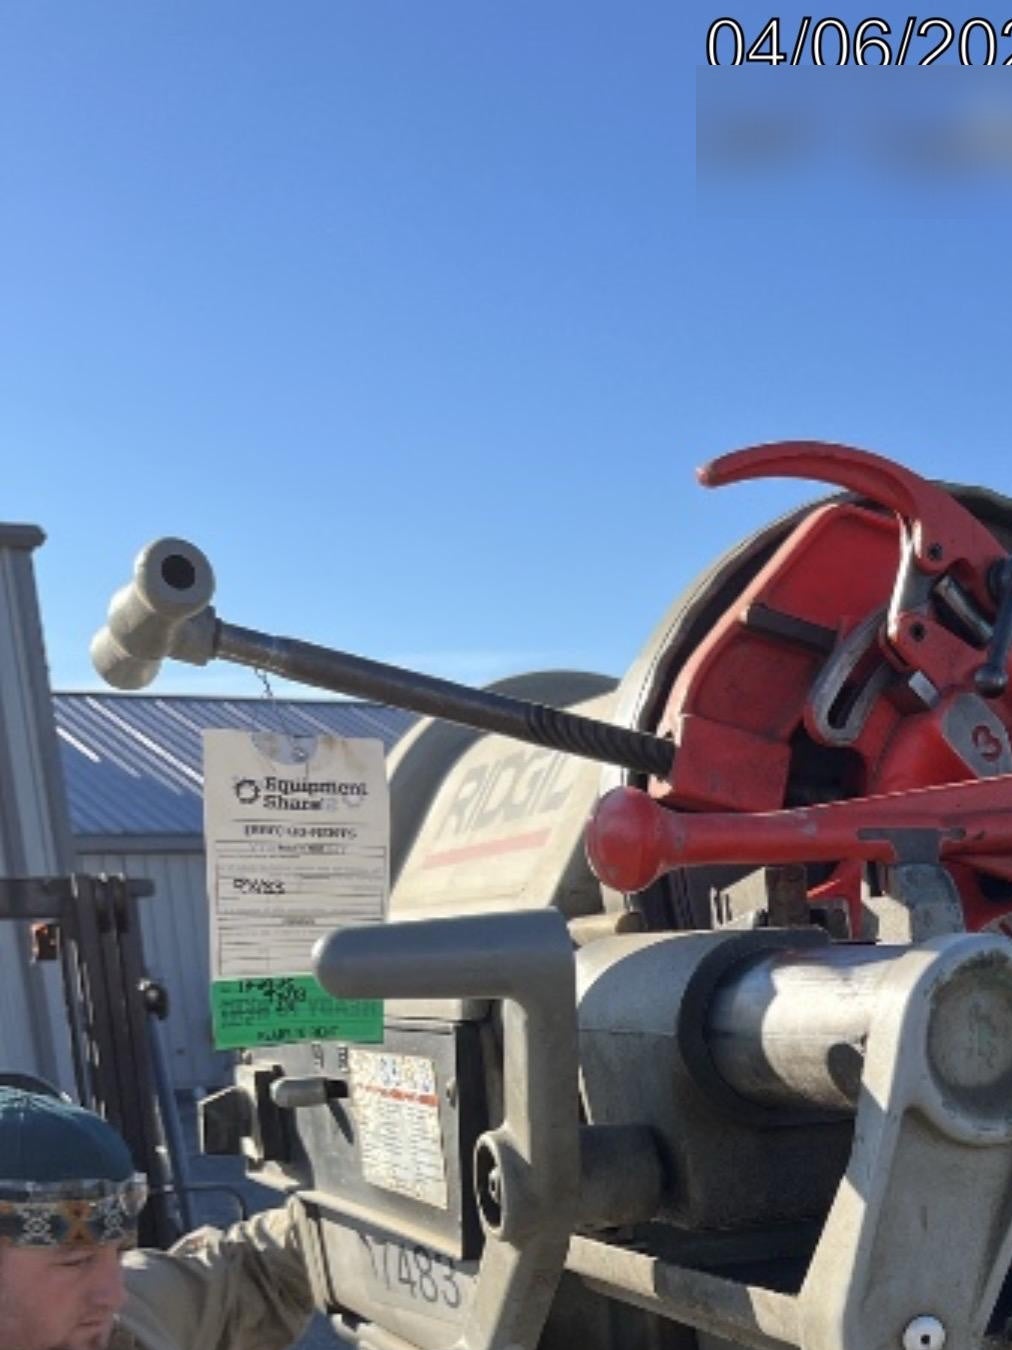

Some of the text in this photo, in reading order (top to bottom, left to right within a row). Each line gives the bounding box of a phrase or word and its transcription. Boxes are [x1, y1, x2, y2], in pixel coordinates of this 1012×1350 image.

[971, 724, 1002, 762] 3
[264, 776, 367, 796] Equipment
[263, 795, 323, 811] Share
